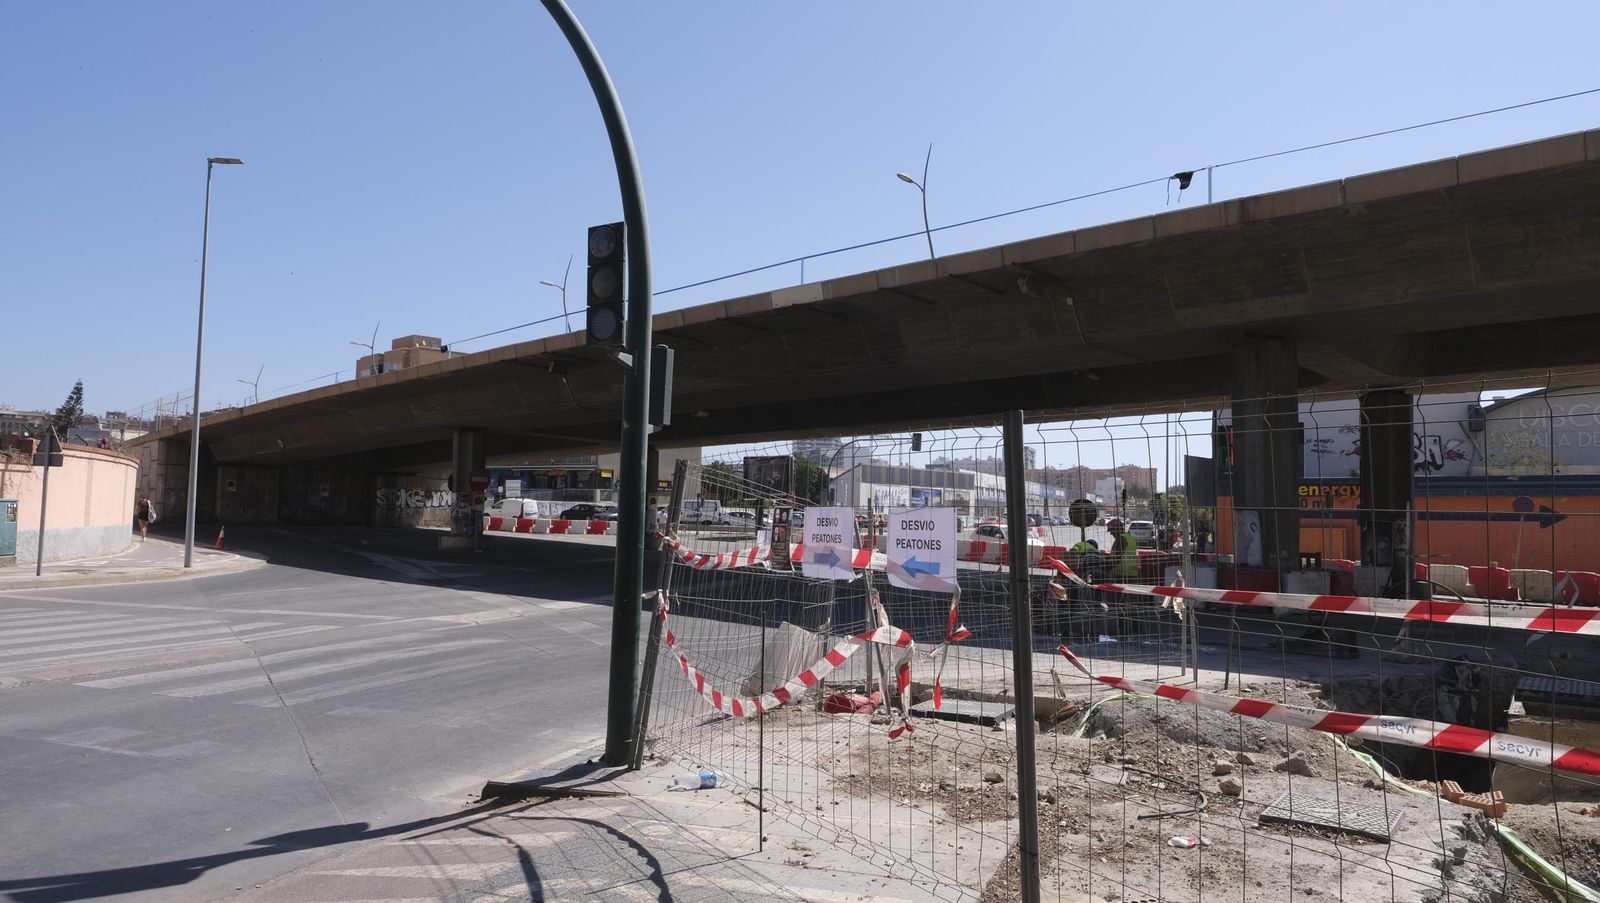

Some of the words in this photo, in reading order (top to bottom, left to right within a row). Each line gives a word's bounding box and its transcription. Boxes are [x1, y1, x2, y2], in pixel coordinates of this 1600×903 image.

[1520, 403, 1600, 428] DISC
[1298, 484, 1360, 498] energy
[816, 517, 839, 527] DESVIO
[901, 520, 935, 531] DESVIO
[811, 533, 842, 544] PEATONES
[896, 537, 941, 551] PEATONES
